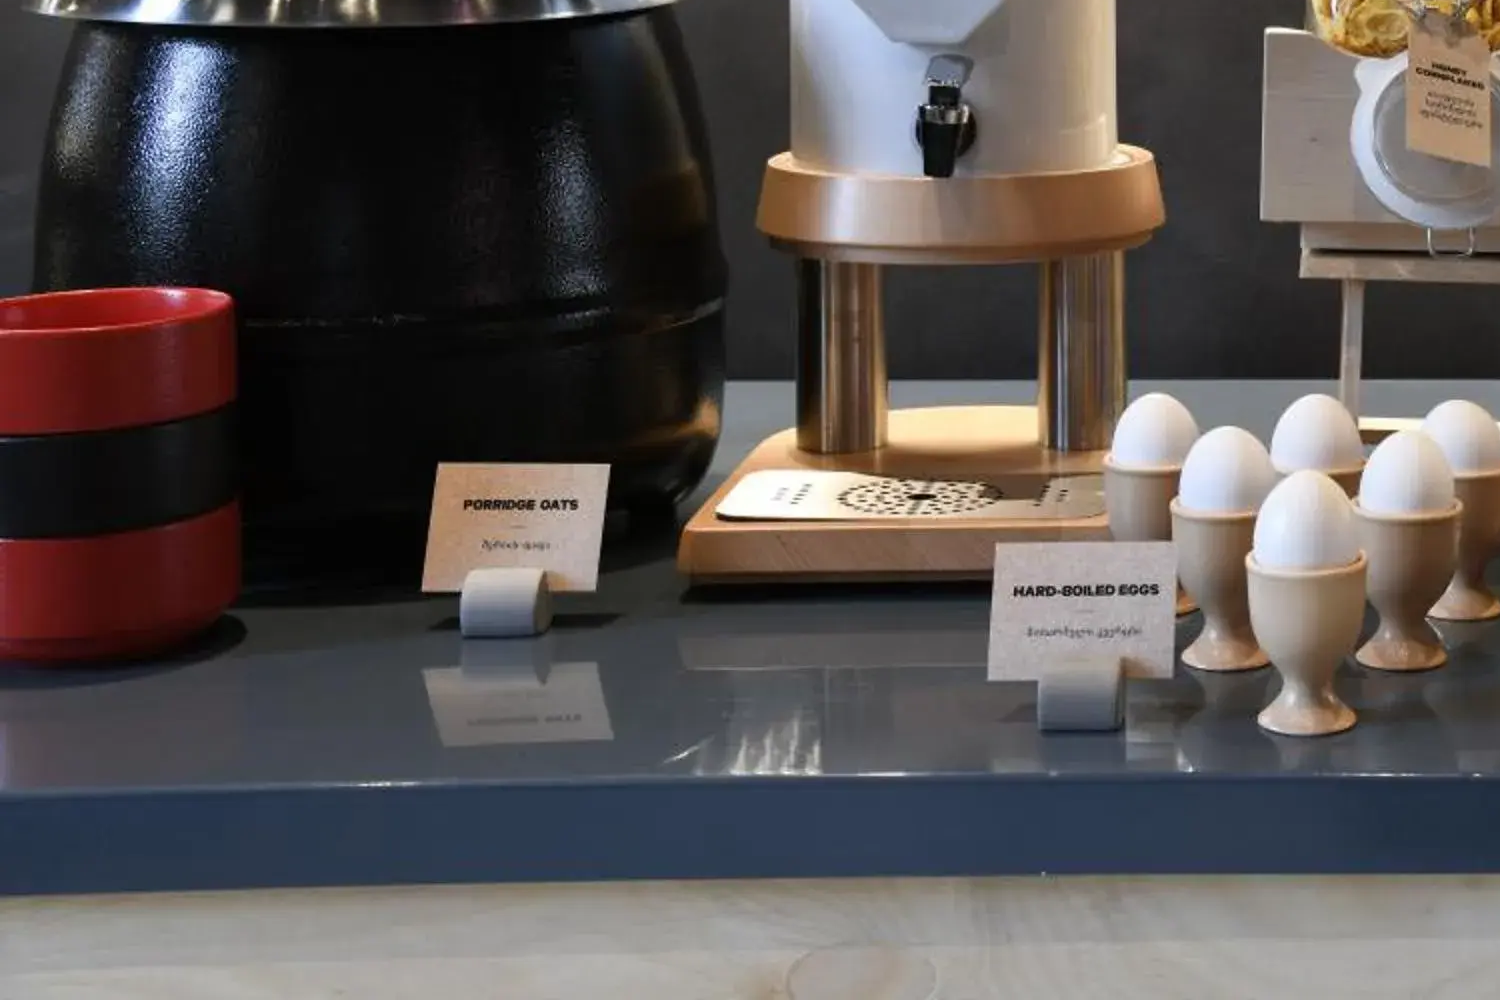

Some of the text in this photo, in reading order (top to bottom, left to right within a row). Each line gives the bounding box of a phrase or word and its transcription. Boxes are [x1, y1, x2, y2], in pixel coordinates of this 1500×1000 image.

[463, 499, 579, 511] PORRIDGE OATS
[1013, 583, 1160, 597] HARD-BOILED EGGS
